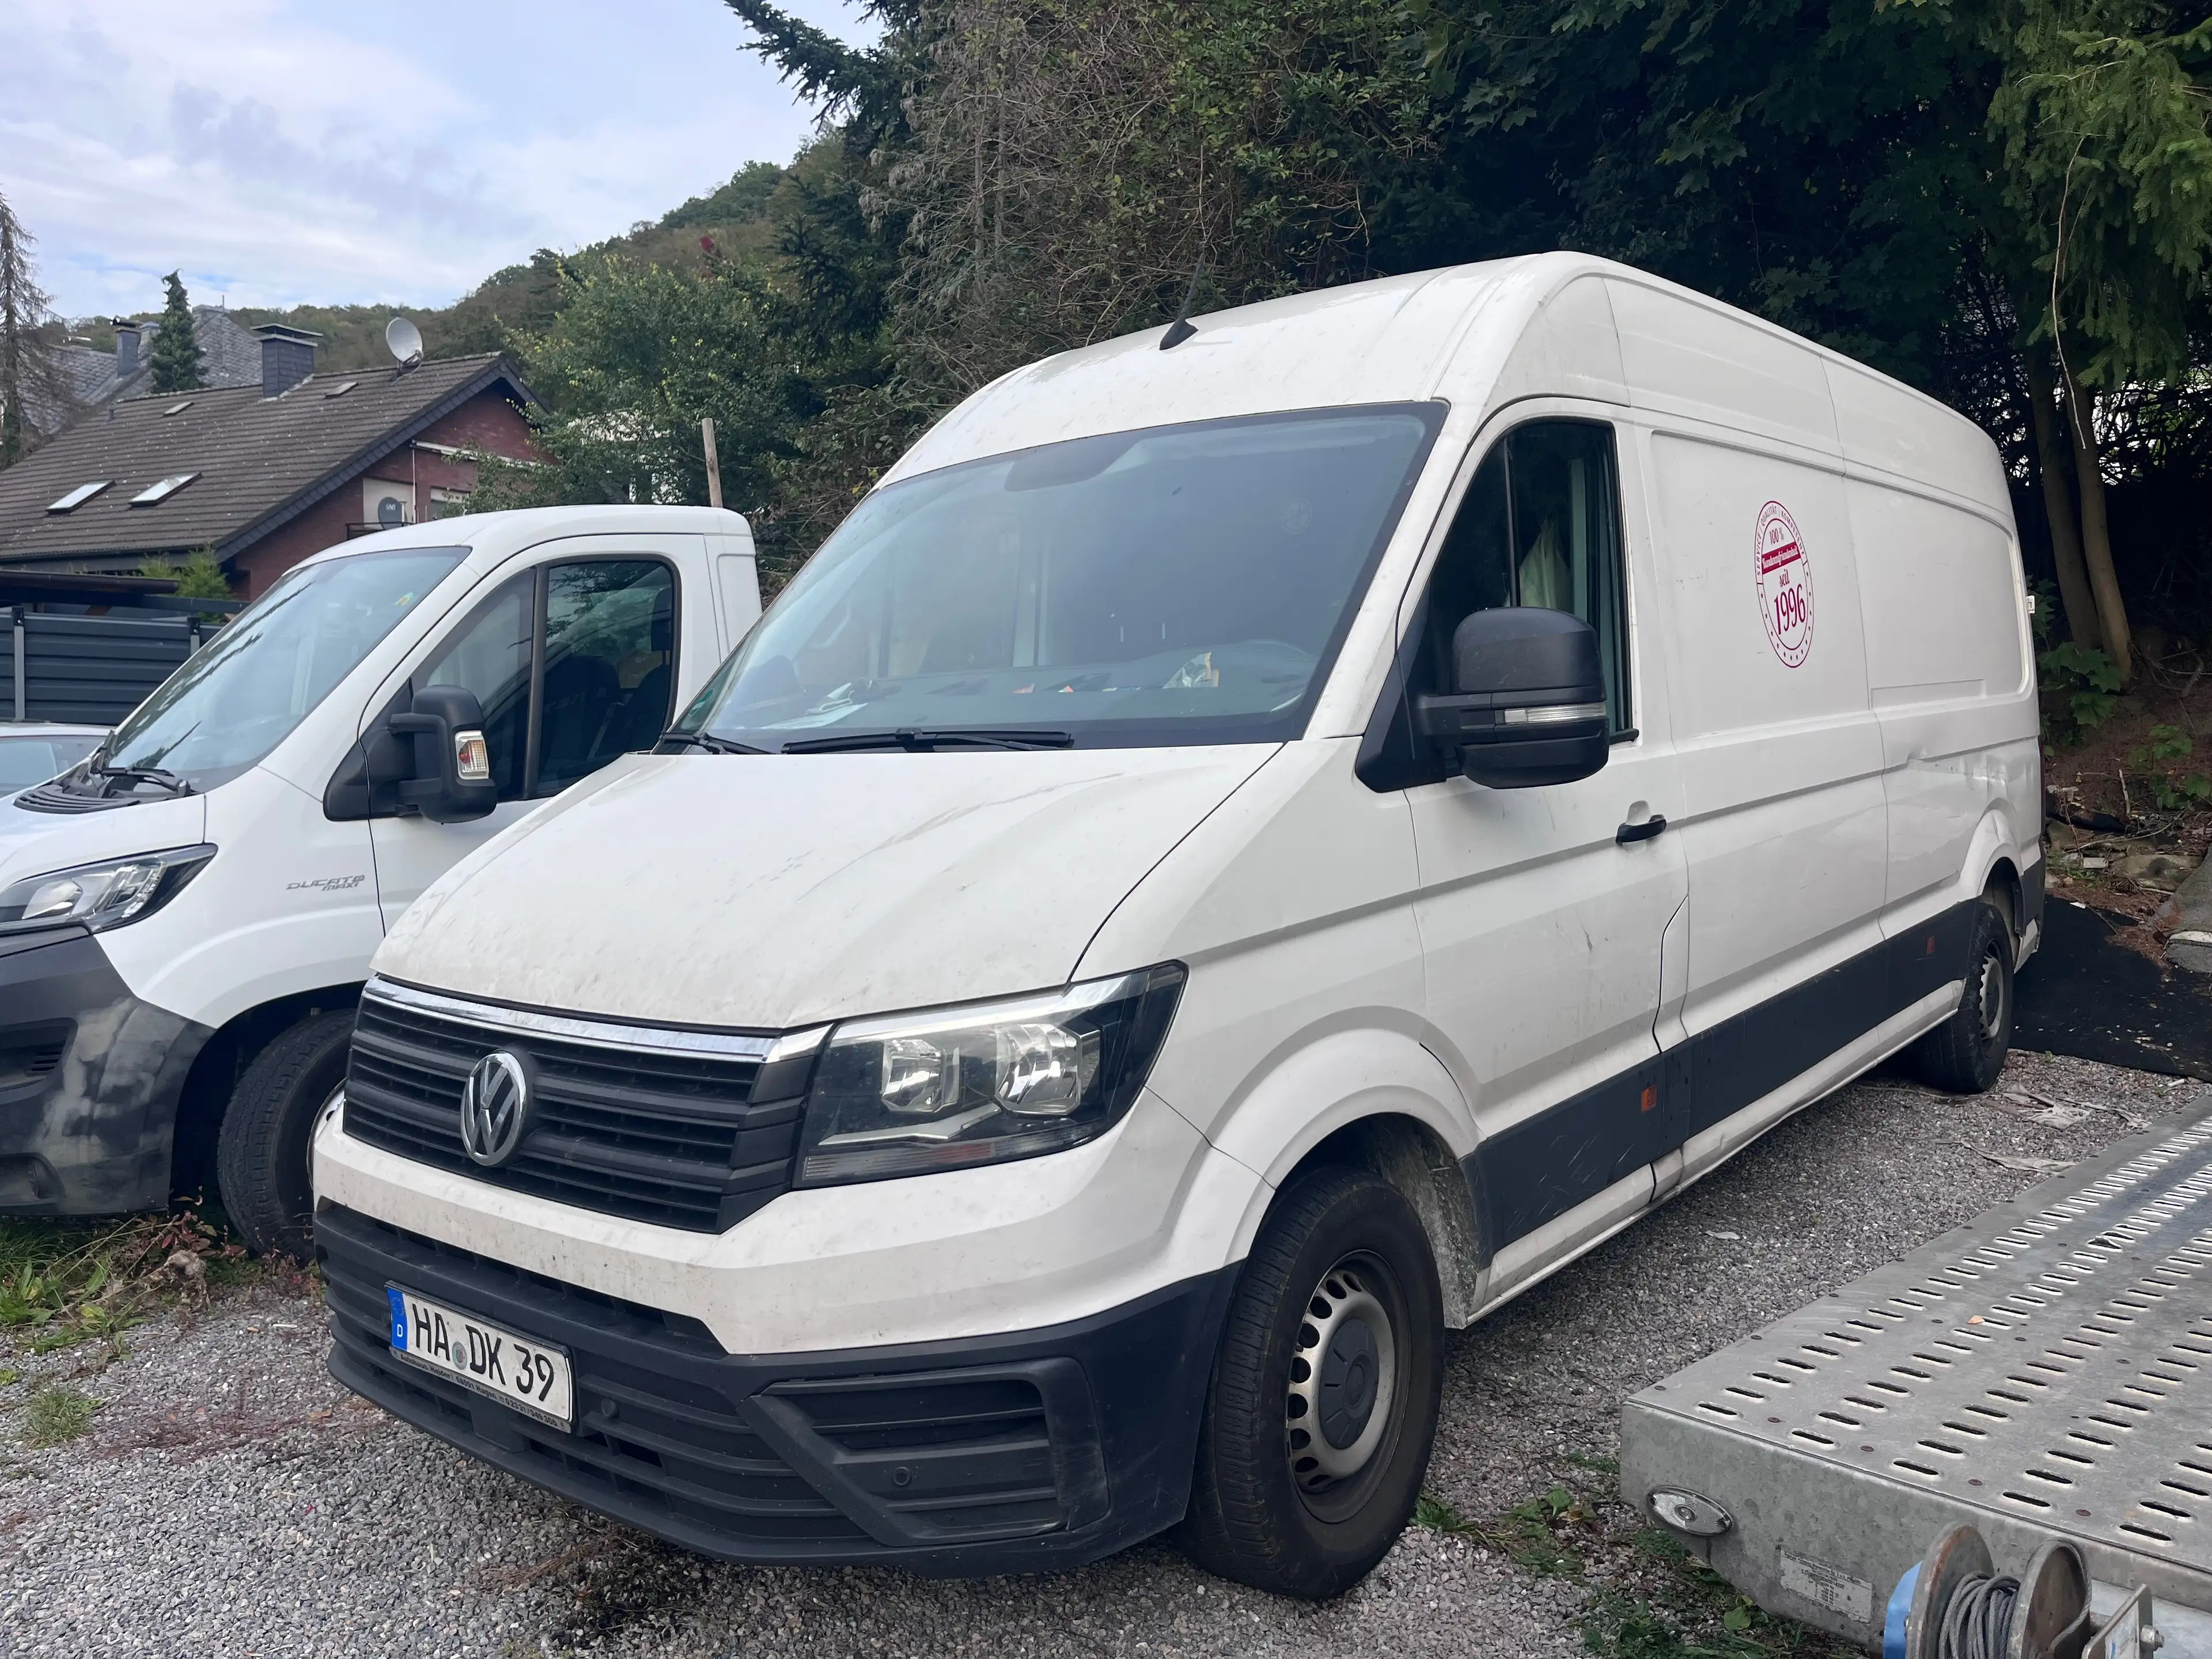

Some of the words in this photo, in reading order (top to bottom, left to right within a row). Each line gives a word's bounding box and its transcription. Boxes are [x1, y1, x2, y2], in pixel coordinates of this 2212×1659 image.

[1760, 504, 1777, 526] QUALITÄT
[1781, 510, 1805, 554] KOMPETENZ
[1769, 528, 1779, 545] 100
[1779, 569, 1790, 587] seit
[1774, 584, 1806, 635] 1996
[286, 875, 366, 889] DUCATO
[321, 882, 359, 891] MAXI
[397, 1324, 403, 1338] D
[412, 1303, 450, 1361] HA
[465, 1324, 506, 1385] DK
[513, 1343, 554, 1402] 39
